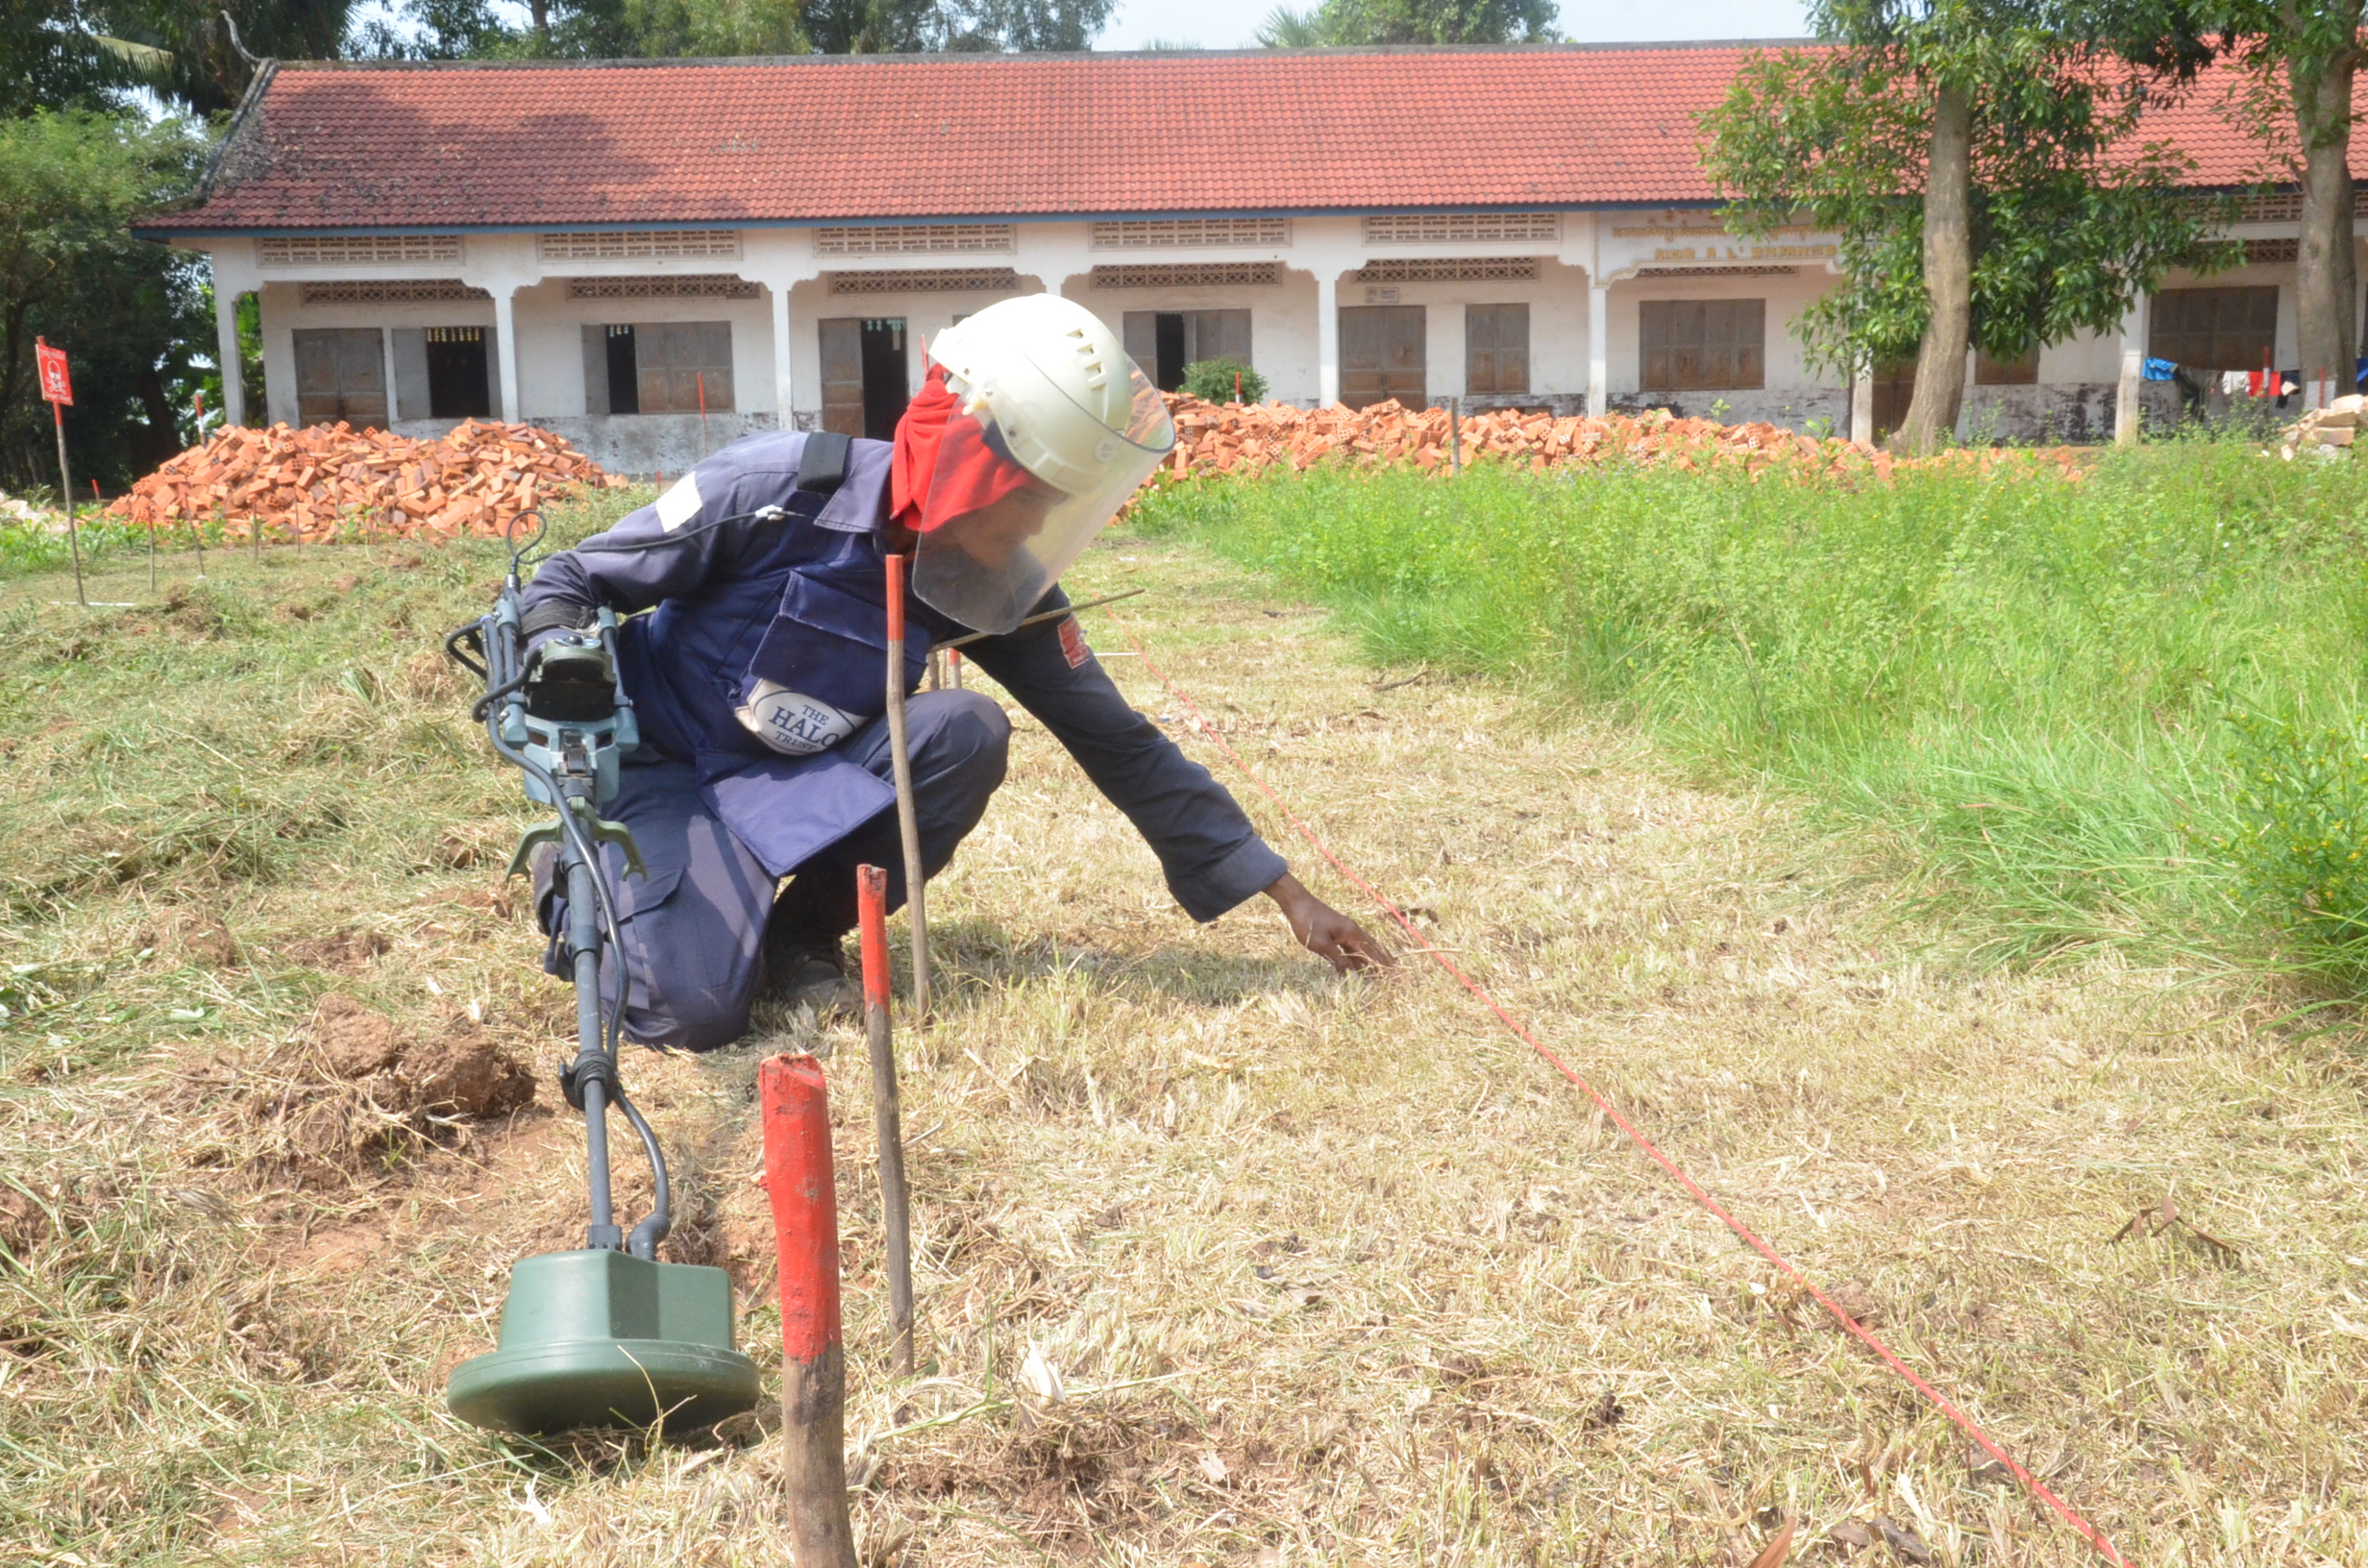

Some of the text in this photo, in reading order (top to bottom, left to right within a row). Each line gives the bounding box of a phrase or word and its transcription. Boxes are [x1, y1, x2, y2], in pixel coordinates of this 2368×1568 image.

[802, 704, 829, 725] THE
[769, 706, 840, 747] HALO
[775, 730, 817, 750] TRUST
